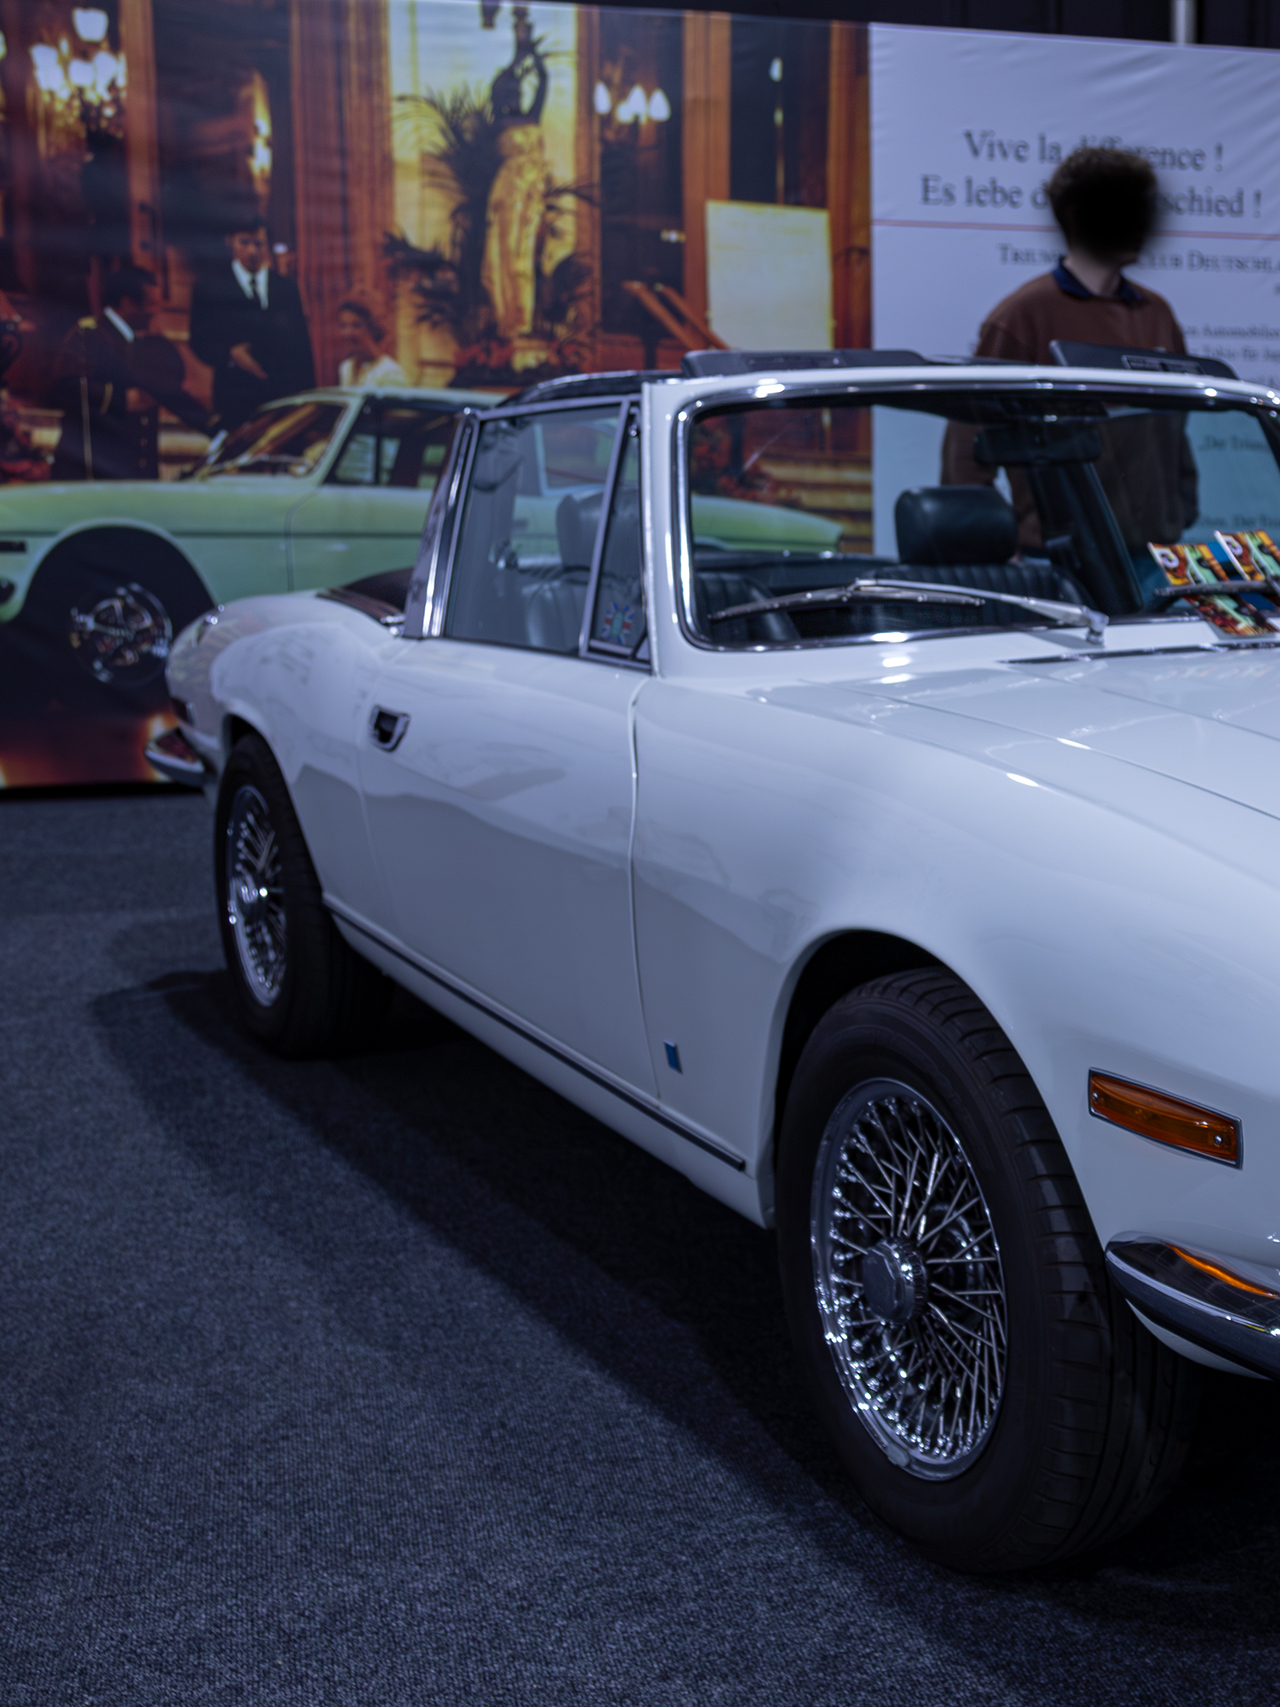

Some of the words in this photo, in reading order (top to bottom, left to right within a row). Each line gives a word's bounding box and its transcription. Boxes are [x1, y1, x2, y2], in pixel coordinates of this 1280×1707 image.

[963, 129, 1029, 162] Vive
[1037, 133, 1064, 164] la
[921, 174, 956, 206] Es
[964, 176, 1023, 209] lebe
